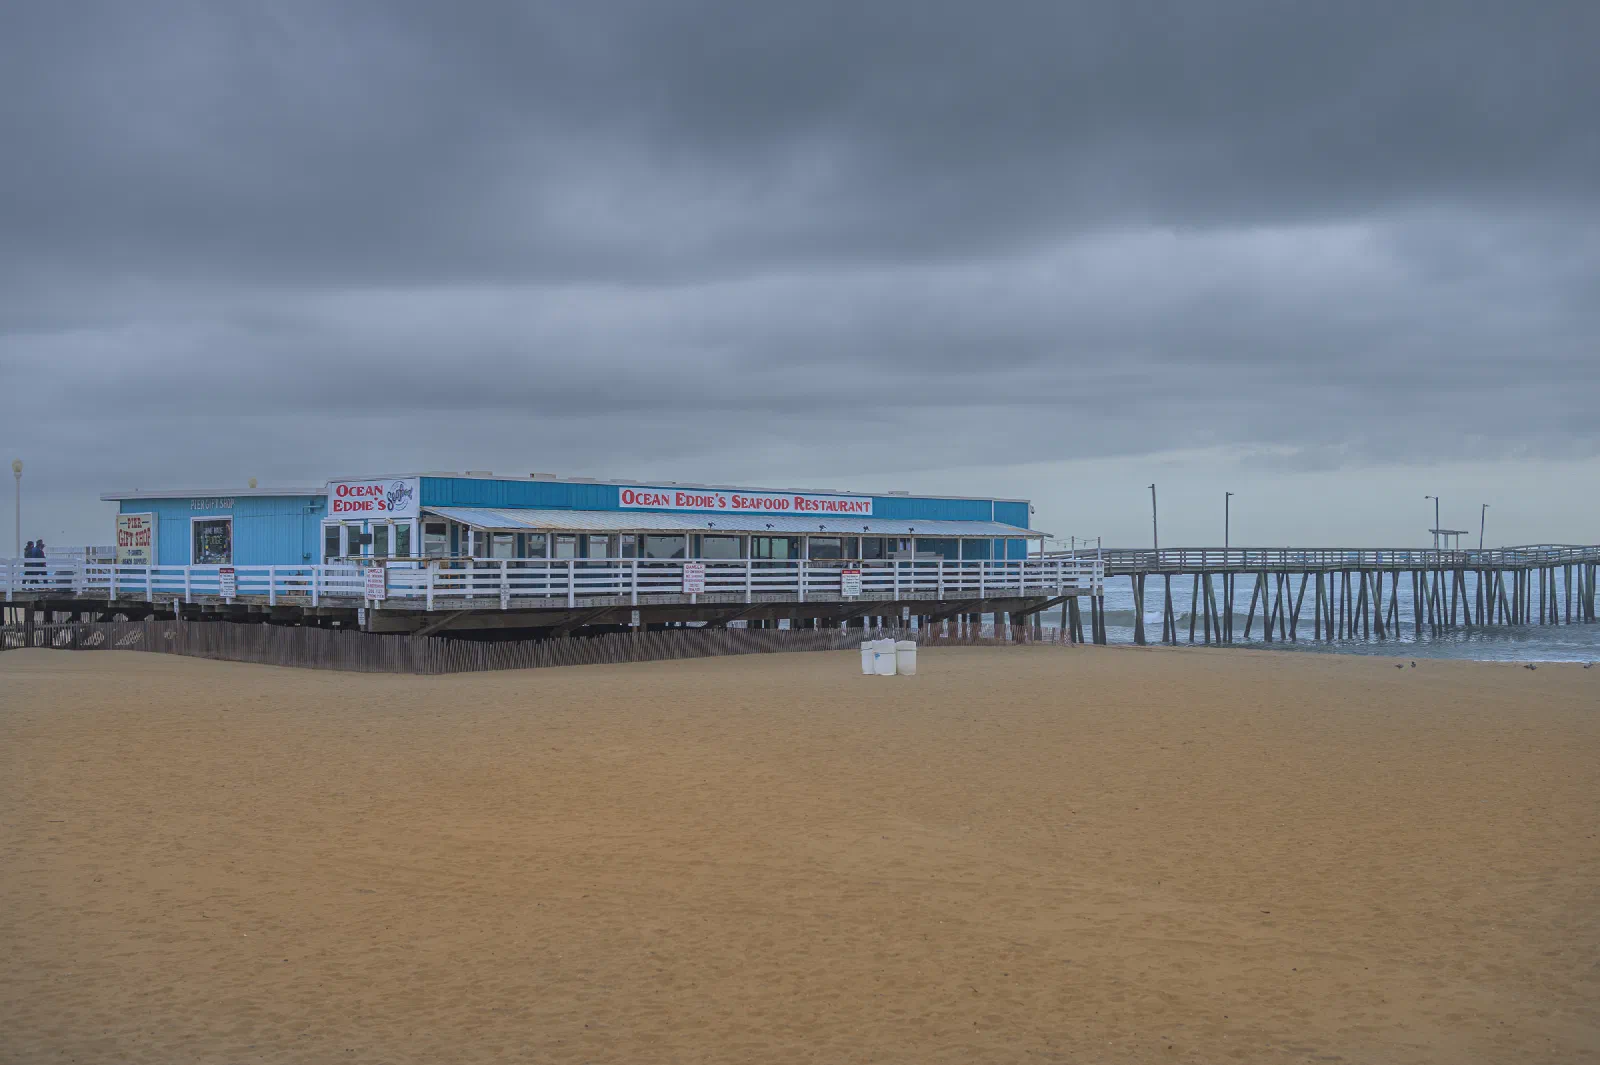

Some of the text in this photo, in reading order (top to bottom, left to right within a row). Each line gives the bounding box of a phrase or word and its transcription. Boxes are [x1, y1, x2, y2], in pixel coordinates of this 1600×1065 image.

[336, 484, 383, 497] OCEAN
[190, 500, 204, 510] PIER
[219, 498, 234, 509] SHOP
[333, 497, 387, 512] EDDIE'S
[621, 489, 871, 513] OCEAN EDDIE'S SEAFOOD RESTAURANT
[127, 517, 142, 529] PIER
[118, 527, 151, 547] GIFT SHOP
